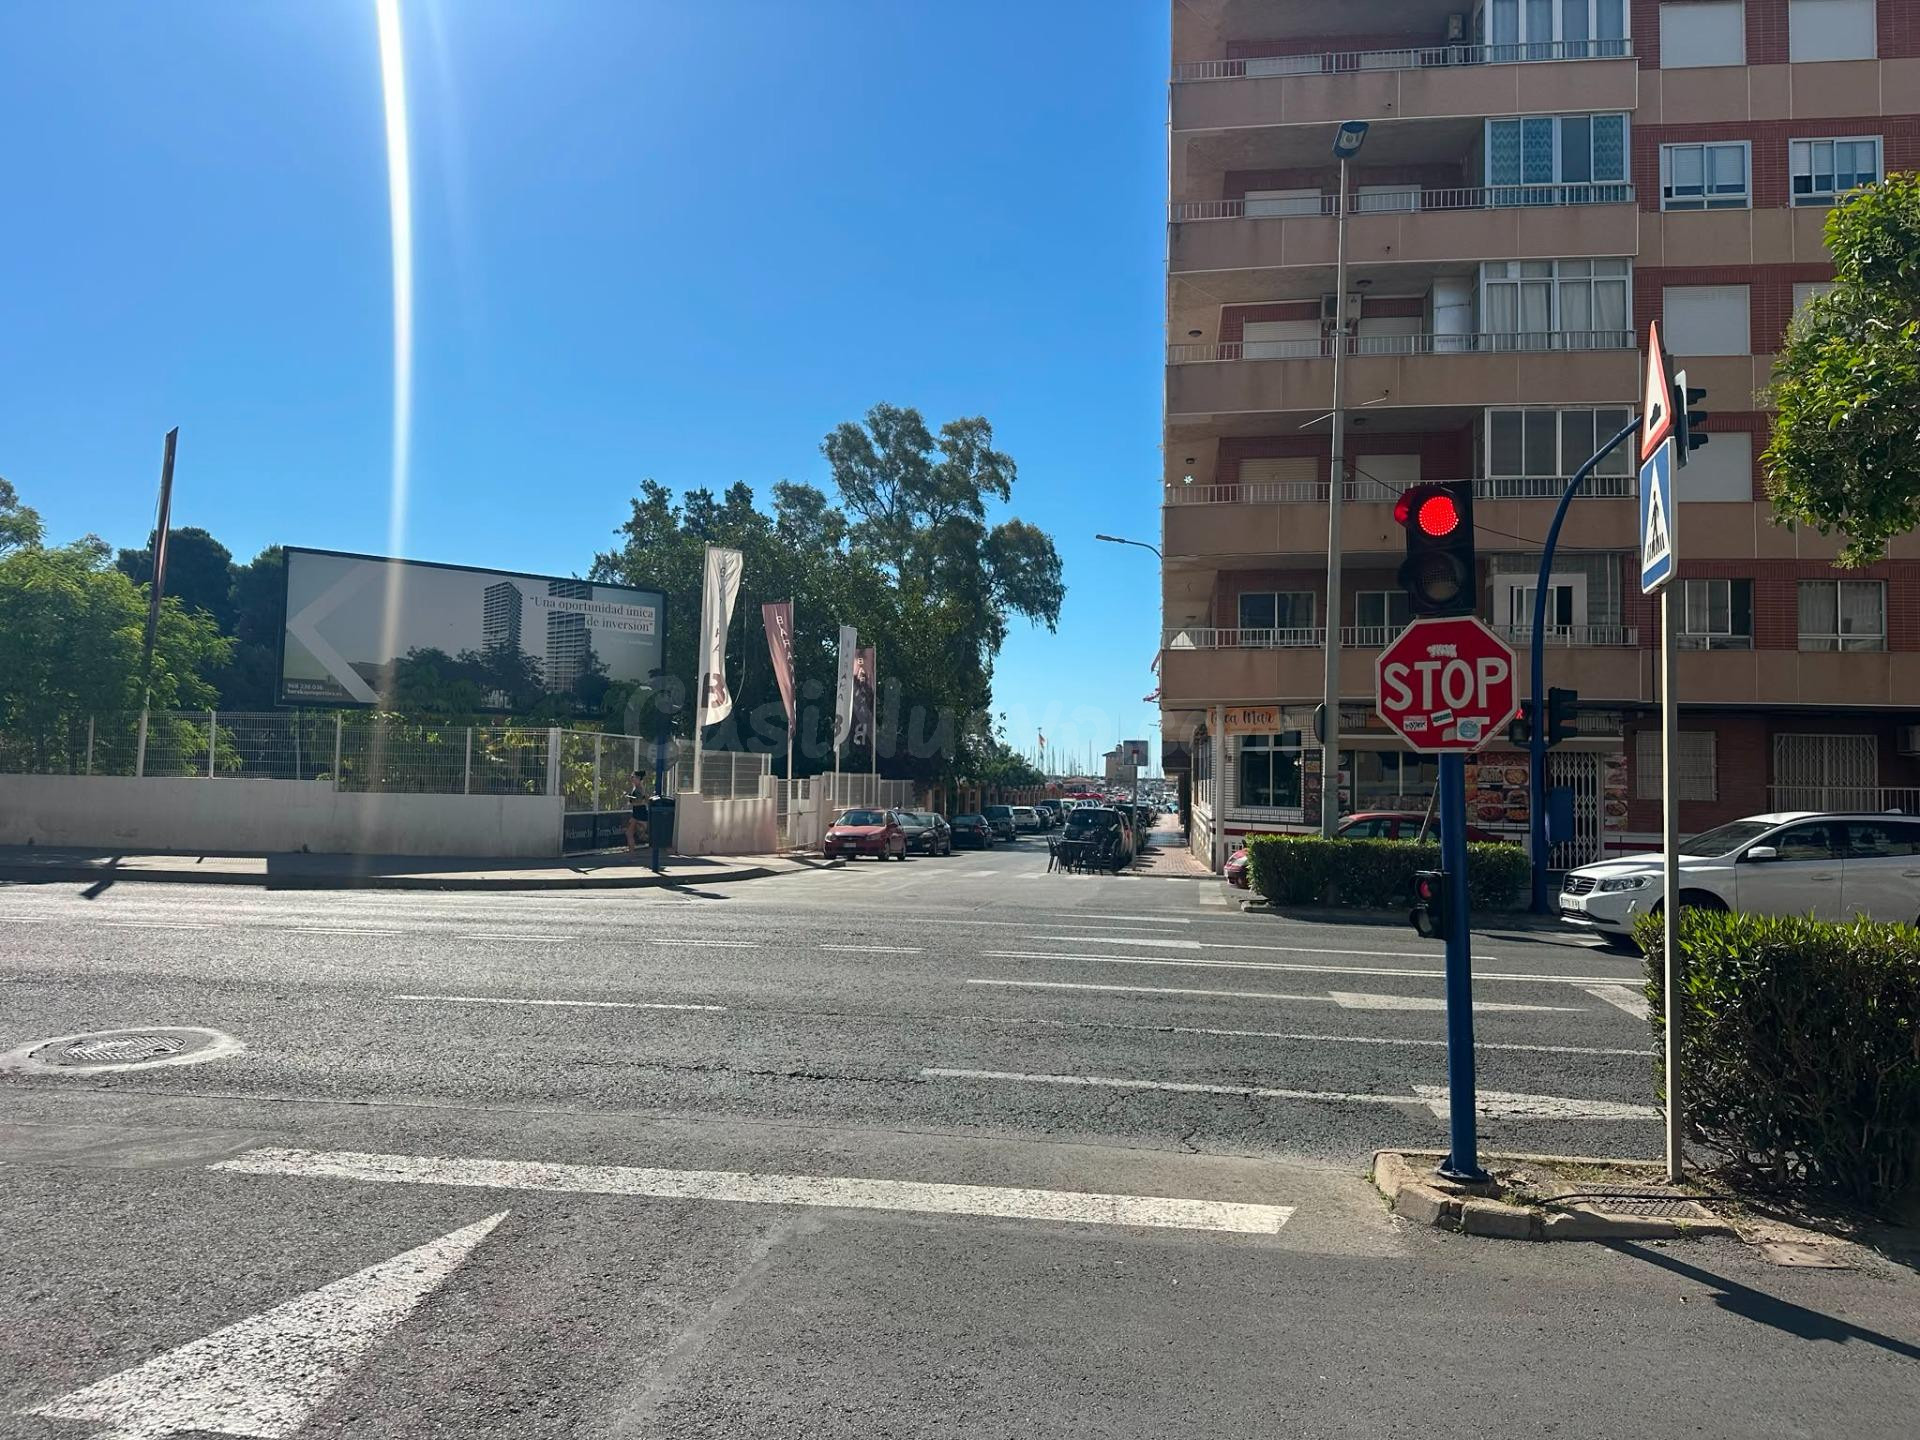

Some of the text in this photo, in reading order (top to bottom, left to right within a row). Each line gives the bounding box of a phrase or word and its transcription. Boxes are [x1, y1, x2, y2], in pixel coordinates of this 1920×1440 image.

[558, 600, 623, 616] oportunidad
[586, 615, 599, 627] de
[1384, 657, 1508, 711] STOP
